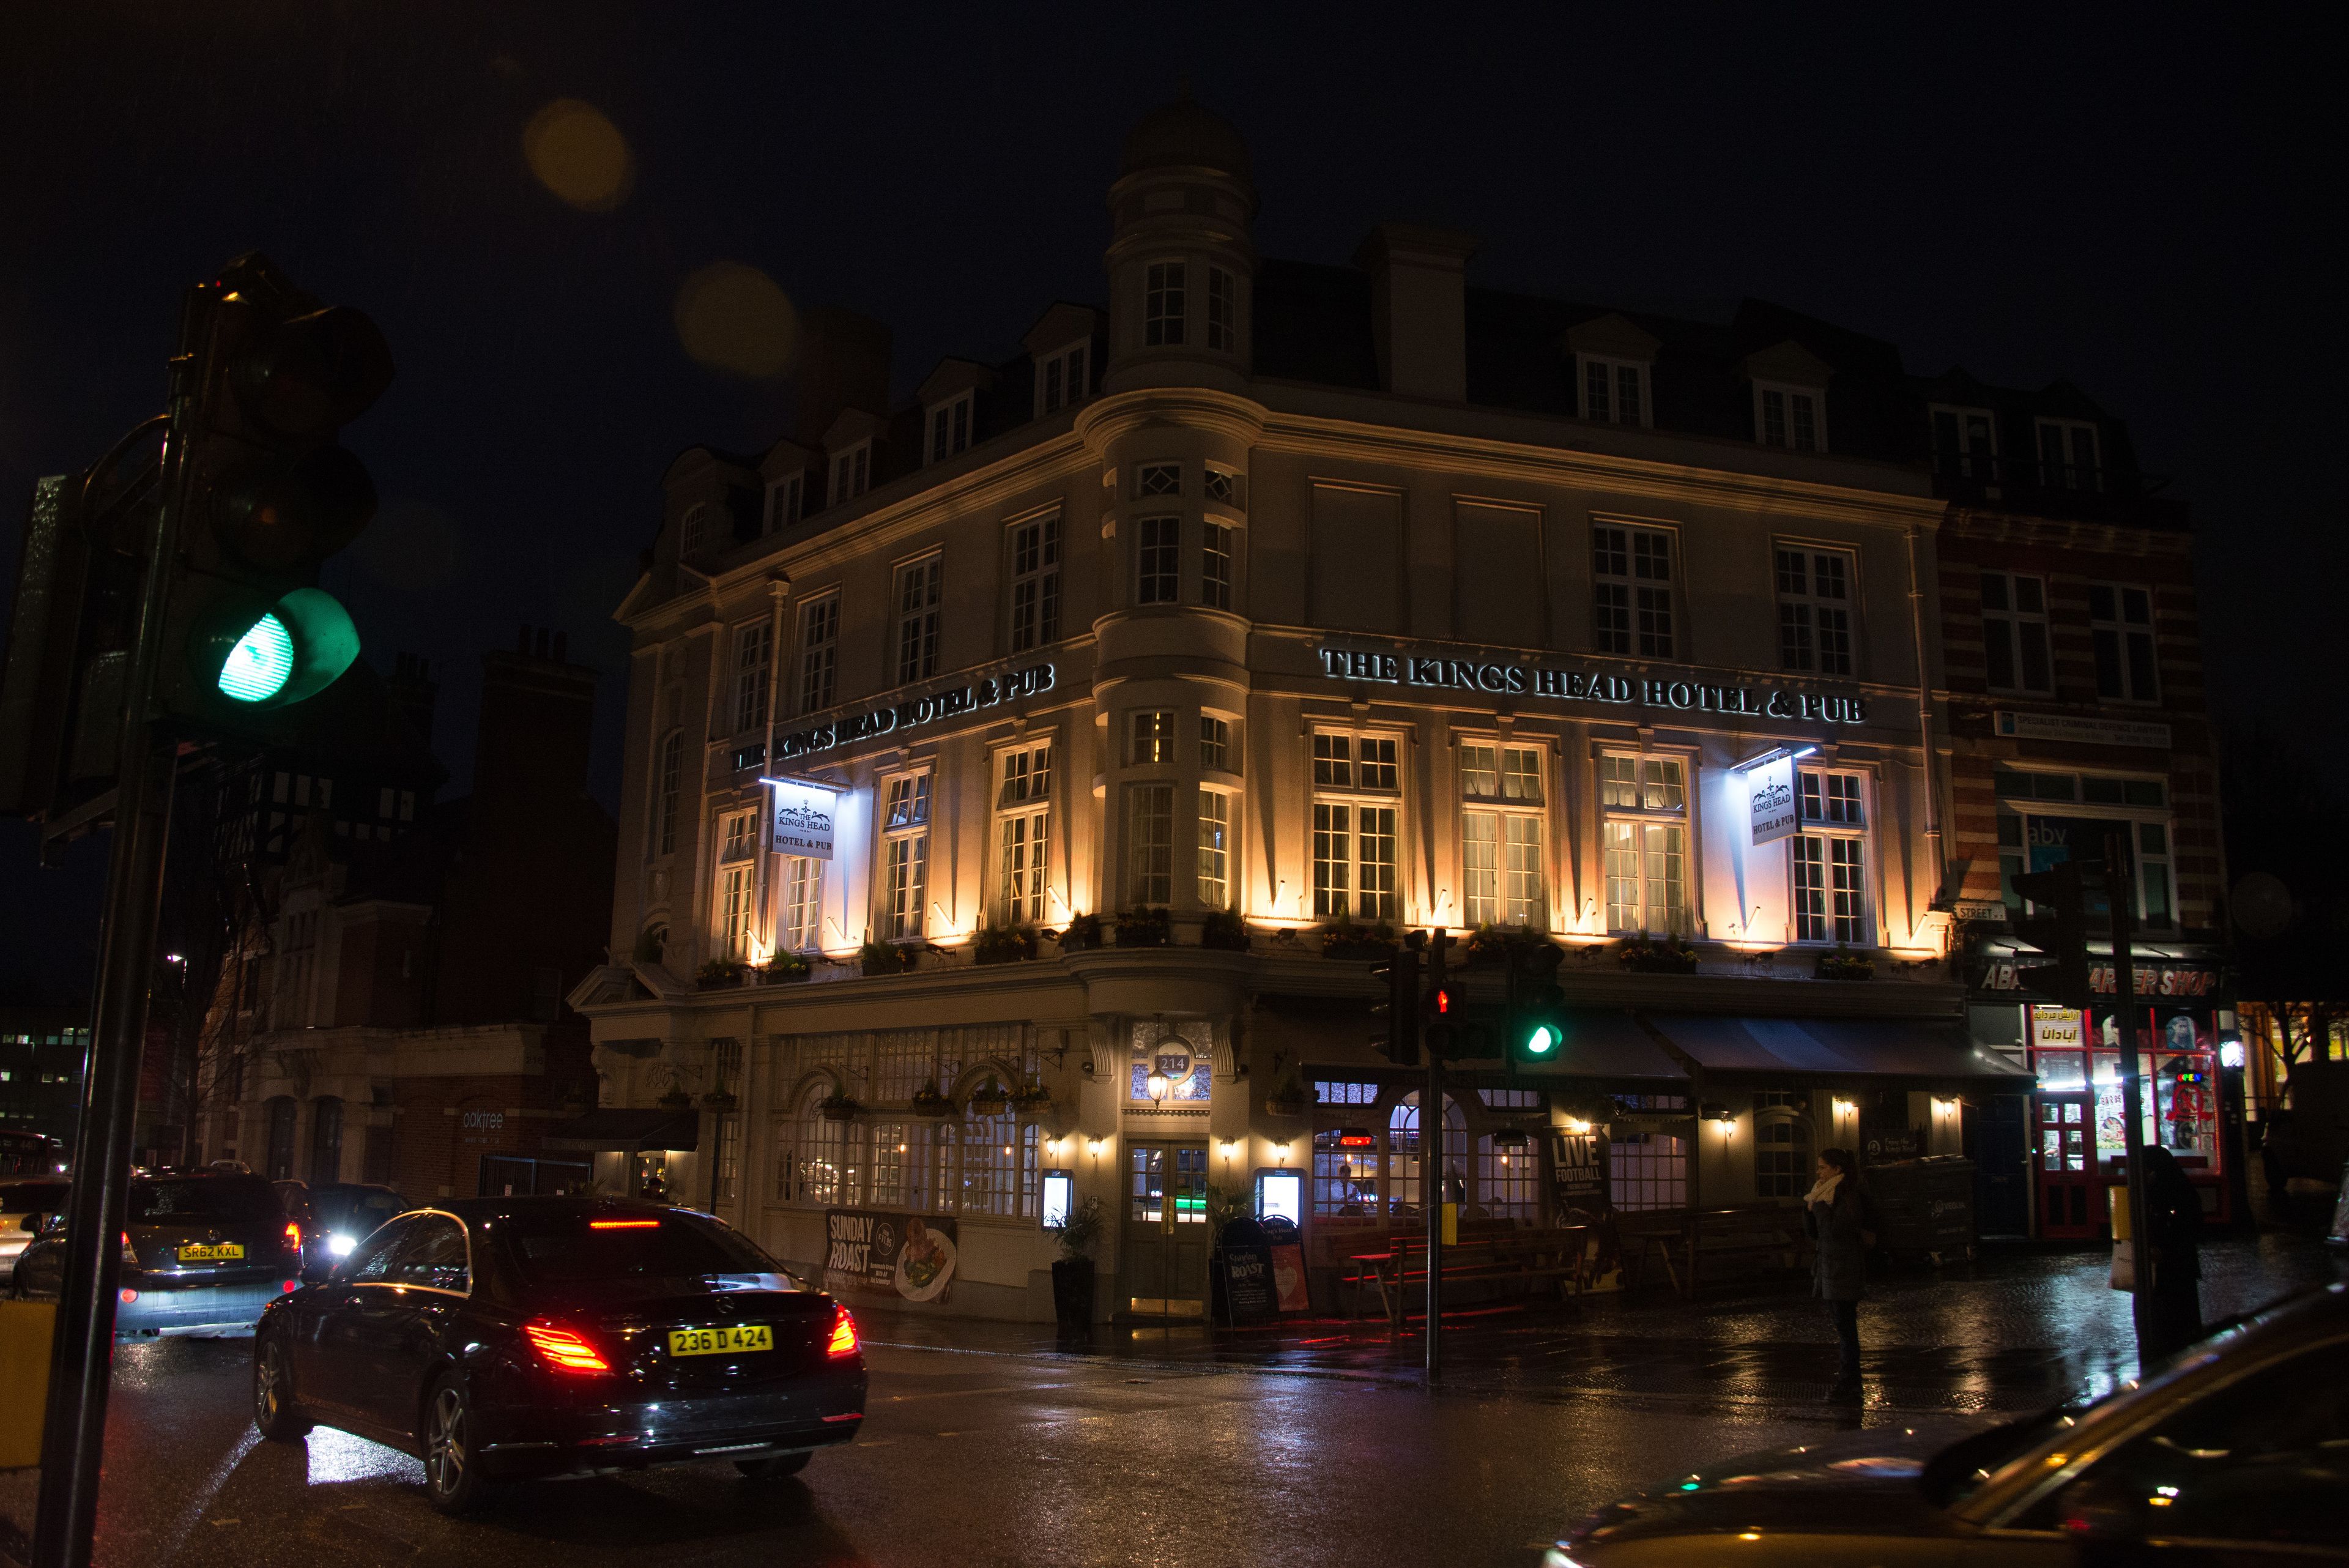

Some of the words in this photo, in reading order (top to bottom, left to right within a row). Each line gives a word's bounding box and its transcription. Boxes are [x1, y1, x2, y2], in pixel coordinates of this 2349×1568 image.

[1319, 648, 1399, 683] THE
[1409, 657, 1527, 693] KINGS
[1534, 669, 1636, 703] HEAD
[1643, 679, 1763, 715] HOTEL
[1768, 691, 1795, 718] &
[1800, 694, 1867, 723] PUB
[773, 721, 837, 762] KINGS
[837, 708, 897, 746] HEAD
[897, 686, 978, 729] HOTEL
[978, 679, 1000, 707] &
[1001, 664, 1055, 702] PUB
[2018, 716, 2059, 726] SPECIALIST
[2061, 718, 2098, 730] CRIMINAL
[1753, 800, 1772, 813] KINGS
[1773, 794, 1791, 806] HEAD
[779, 817, 805, 828] KINGS
[807, 821, 830, 831] HEAD
[1753, 820, 1773, 834] HOTEL
[1775, 819, 1780, 827] &
[1781, 814, 1794, 826] PUB
[776, 835, 805, 847] HOTEL
[816, 841, 832, 850] PUB
[1960, 908, 1992, 918] STREET
[2088, 968, 2158, 995] ARER
[2159, 970, 2216, 996] SHOP
[1162, 1058, 1184, 1069] 214
[2177, 1073, 2202, 1082] OPEN
[463, 1109, 503, 1132] oaktree
[1552, 1136, 1600, 1168] LIVE
[1556, 1167, 1601, 1183] FOOTBALL
[830, 1214, 874, 1243] SUNDAY
[185, 1247, 214, 1258] SR62
[217, 1246, 239, 1257] KXL
[828, 1241, 871, 1273] ROAST
[1231, 1263, 1264, 1279] ROAST
[675, 1332, 711, 1351] 236
[716, 1331, 728, 1349] D
[733, 1328, 767, 1348] 424
